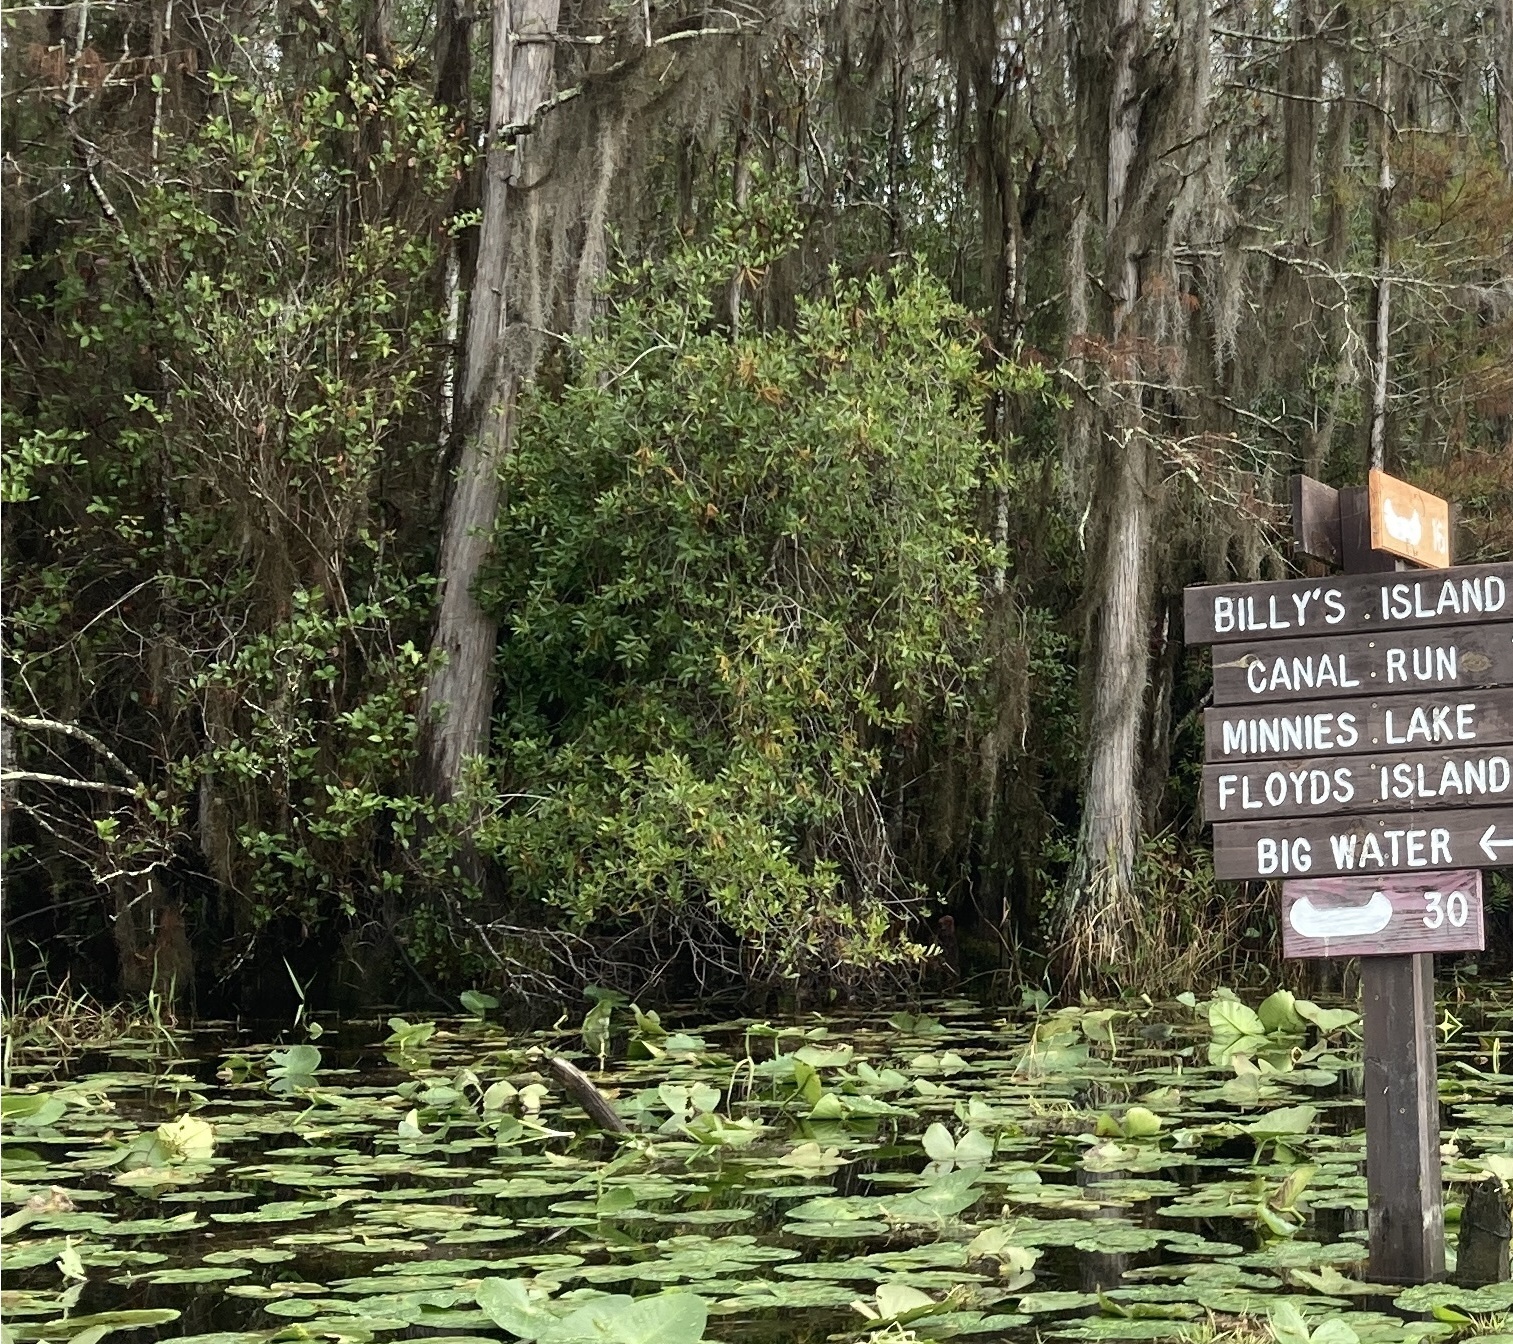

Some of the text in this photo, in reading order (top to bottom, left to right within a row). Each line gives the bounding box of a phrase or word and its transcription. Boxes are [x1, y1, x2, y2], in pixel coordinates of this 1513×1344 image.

[1213, 575, 1506, 633] BILLY'S ISLAND
[1246, 645, 1457, 694] CANAL RUN
[1222, 703, 1477, 755] MINNIES LAKE
[1218, 756, 1511, 811] FLOYDS ISLAND
[1257, 828, 1453, 875] BIG WATER
[1423, 890, 1469, 930] 30
